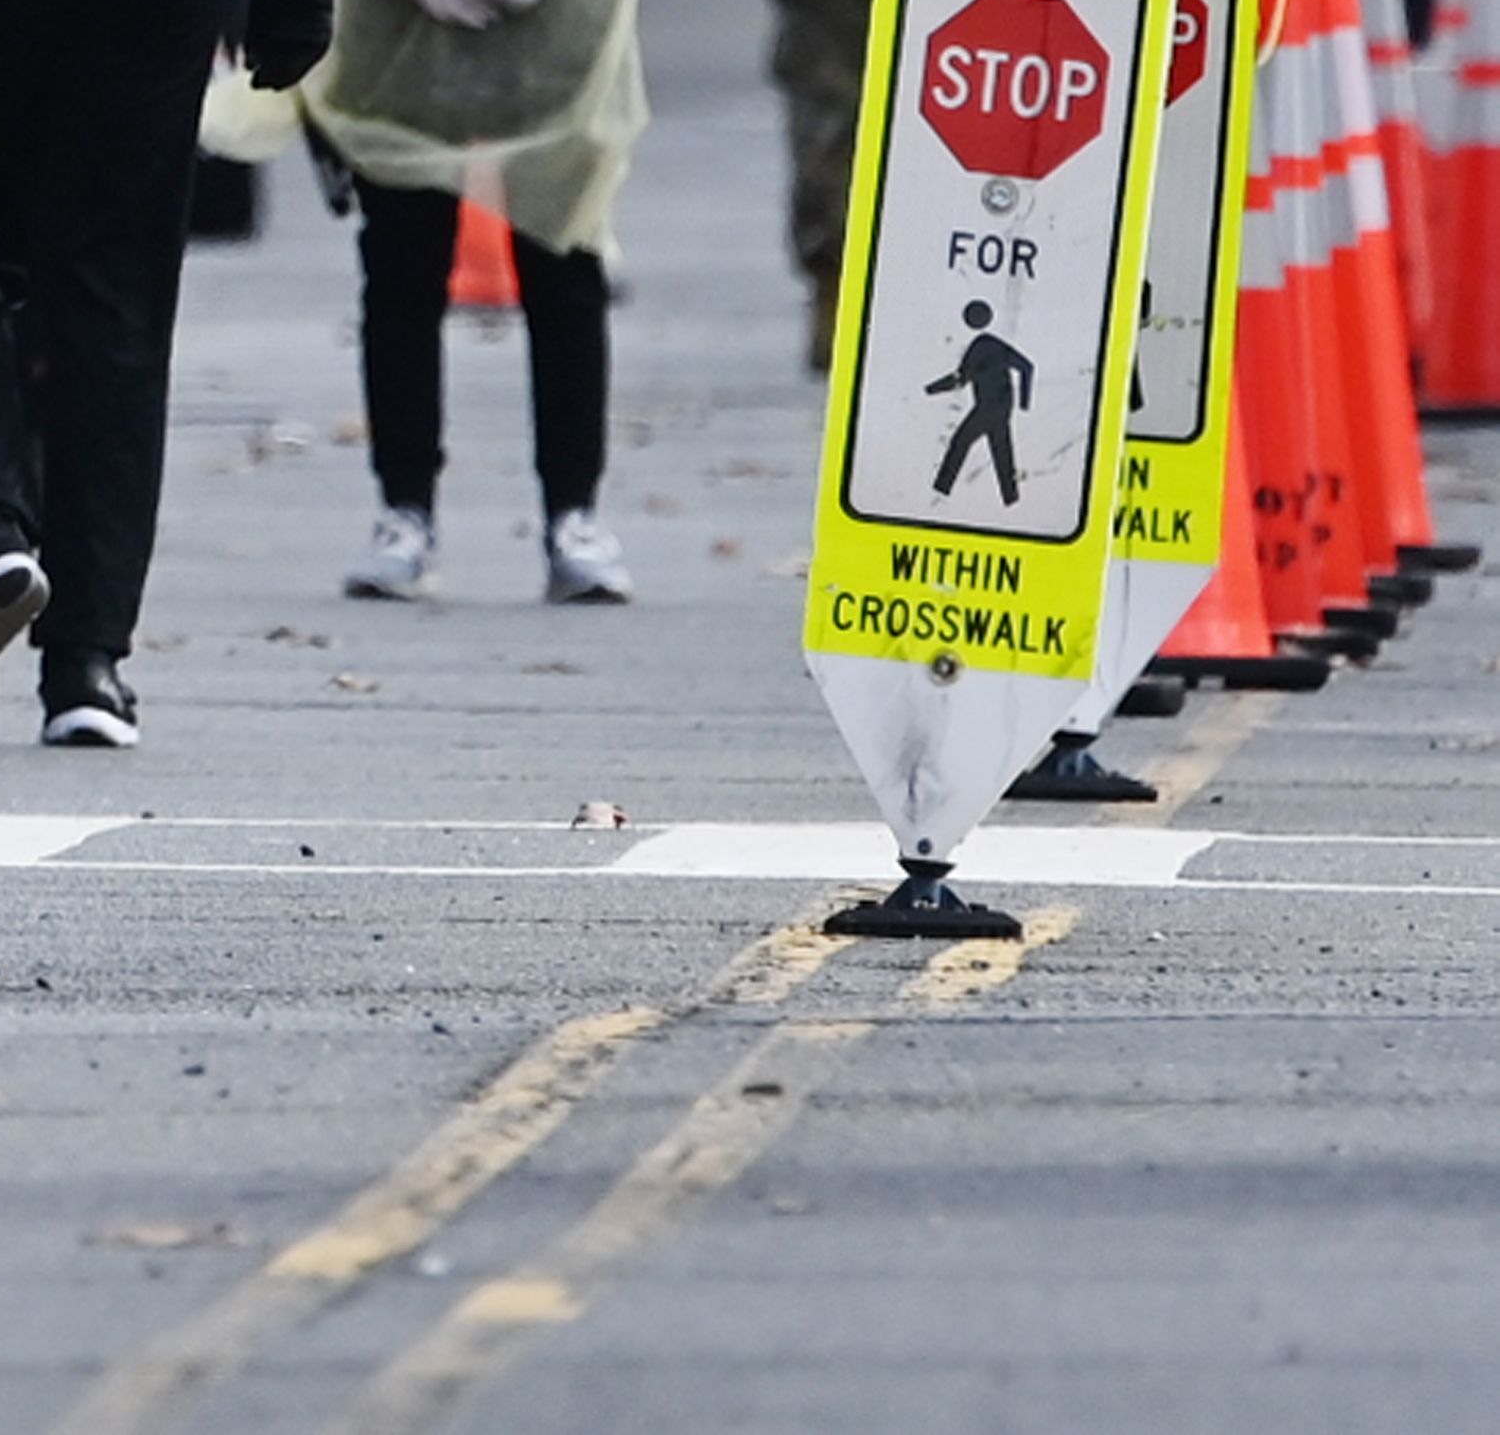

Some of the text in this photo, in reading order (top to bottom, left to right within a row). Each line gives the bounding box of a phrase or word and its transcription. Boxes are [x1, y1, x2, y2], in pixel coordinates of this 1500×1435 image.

[932, 44, 1098, 122] STOP
[948, 231, 1038, 279] FOR
[891, 543, 1021, 594] WITHIN
[832, 591, 1067, 655] CROSSWALK
